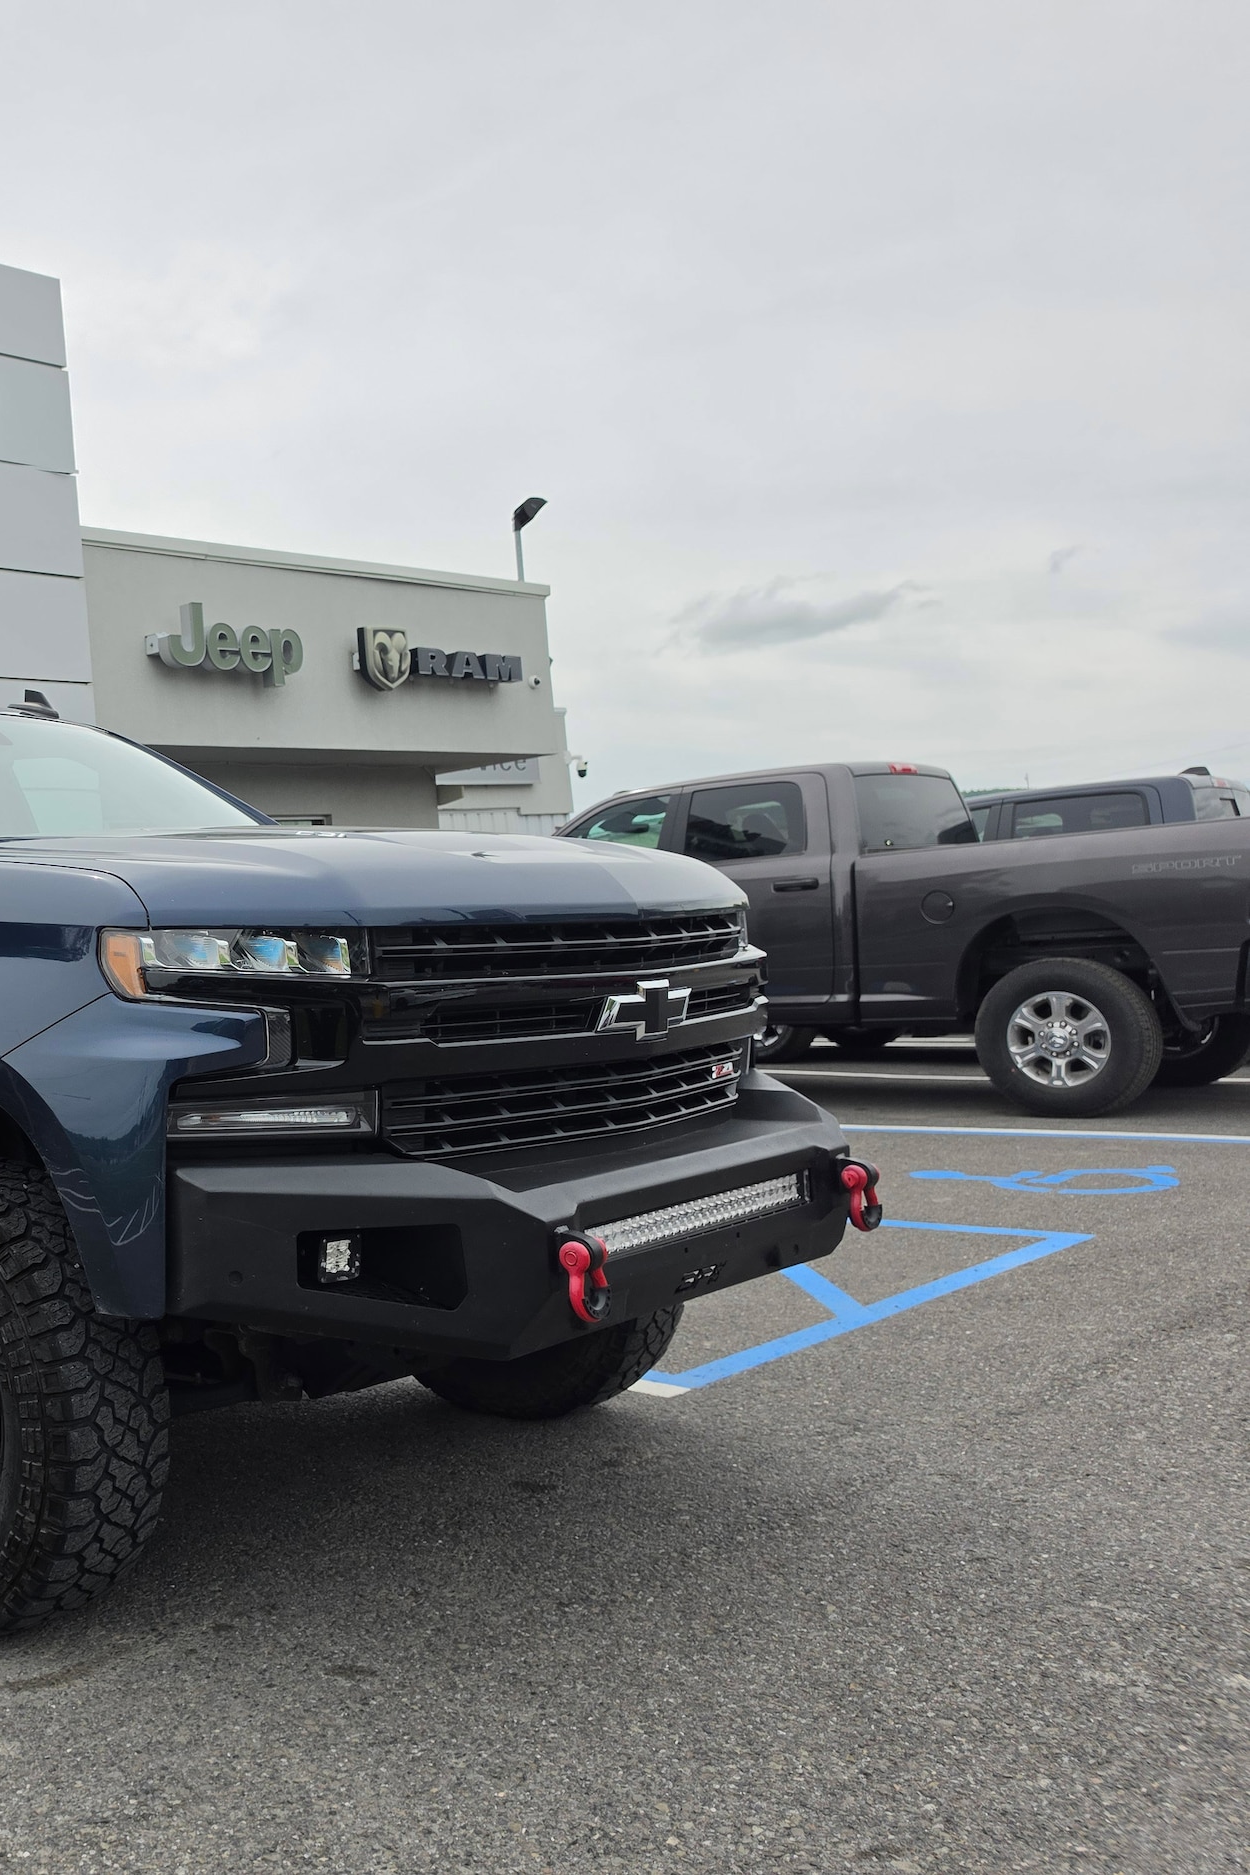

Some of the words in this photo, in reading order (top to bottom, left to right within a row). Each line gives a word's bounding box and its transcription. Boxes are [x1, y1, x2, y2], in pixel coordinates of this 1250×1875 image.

[158, 602, 303, 687] Jeep
[410, 647, 523, 682] RAM
[1132, 855, 1242, 874] SPORT
